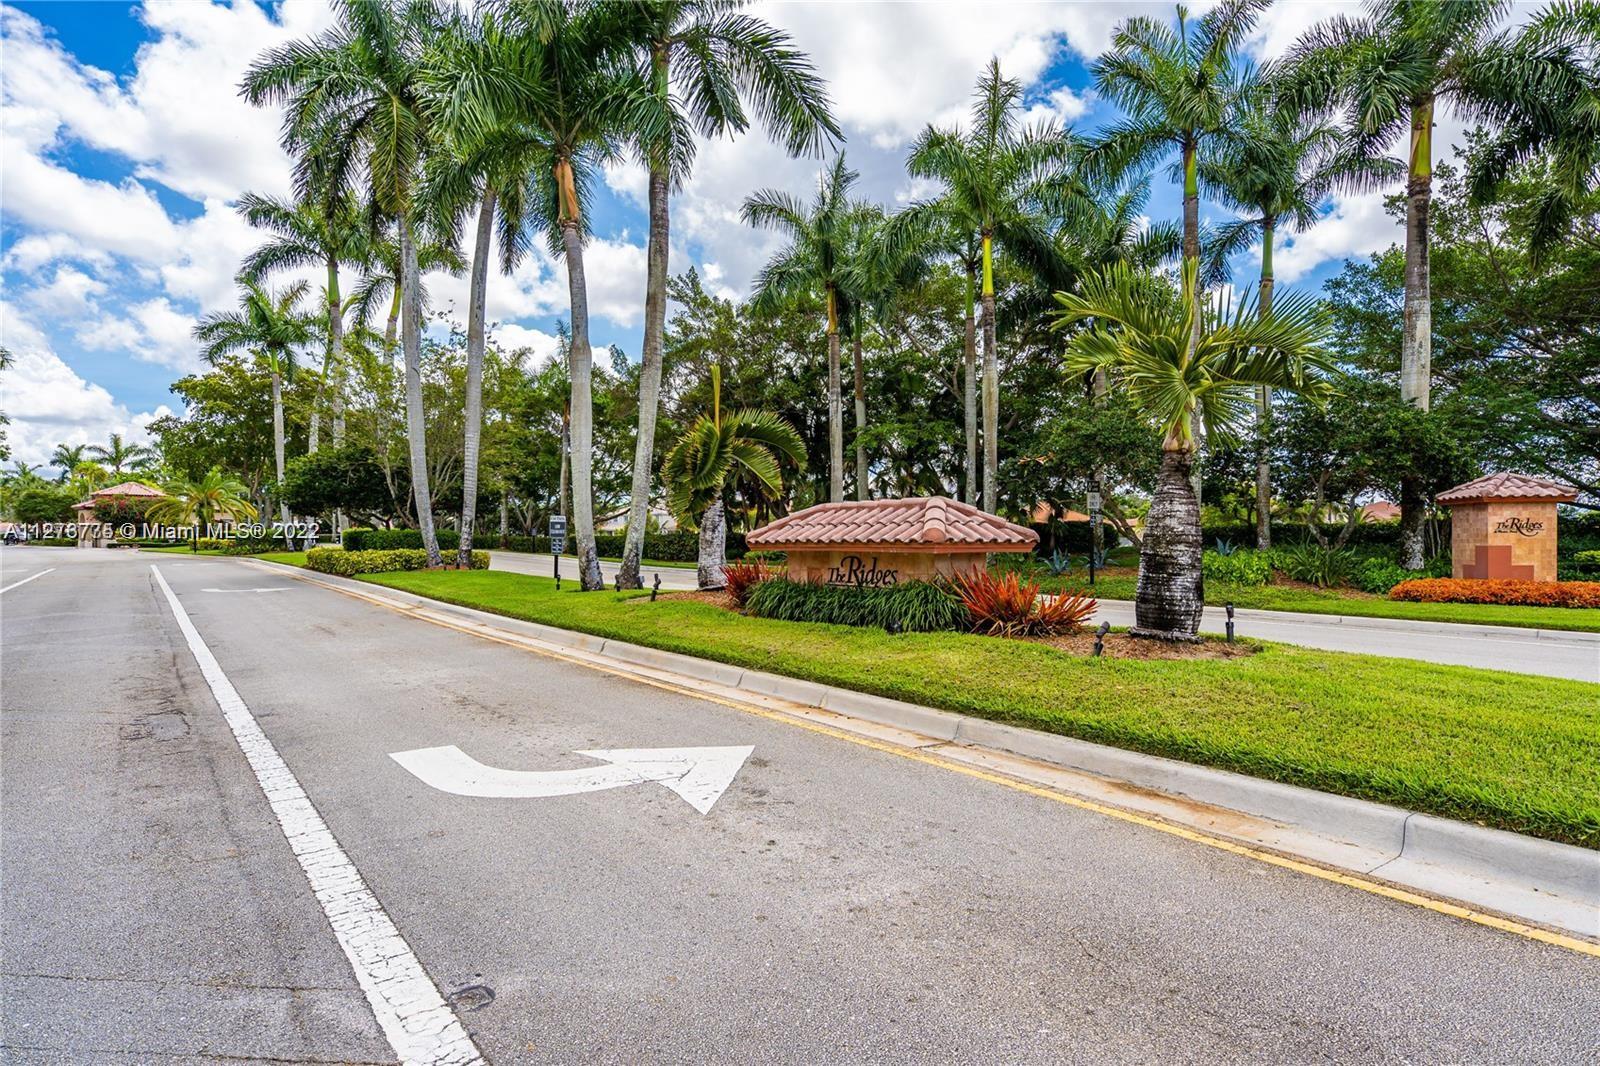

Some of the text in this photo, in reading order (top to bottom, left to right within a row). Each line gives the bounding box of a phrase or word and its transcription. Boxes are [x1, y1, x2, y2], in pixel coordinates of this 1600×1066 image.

[1496, 517, 1544, 537] The Ridges
[827, 555, 899, 588] The Ridges
